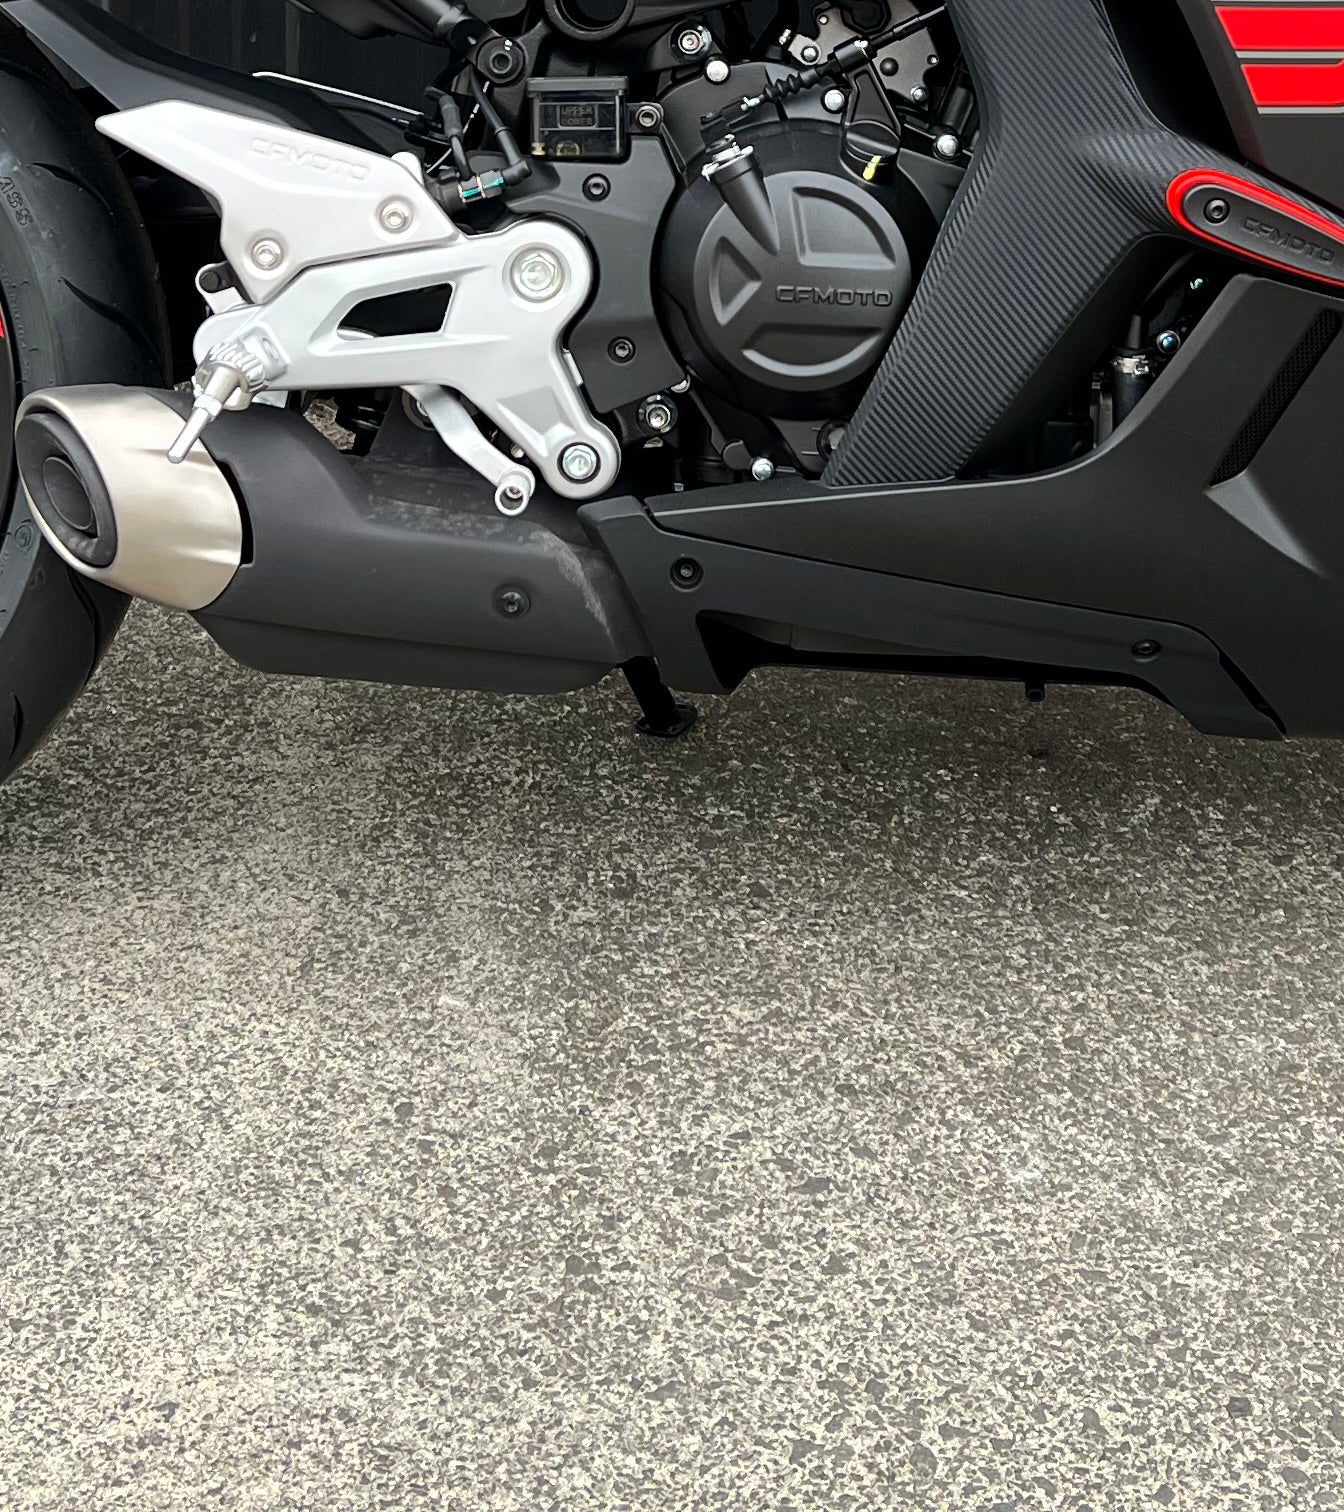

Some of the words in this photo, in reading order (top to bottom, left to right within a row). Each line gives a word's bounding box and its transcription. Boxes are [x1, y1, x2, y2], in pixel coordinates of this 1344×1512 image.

[560, 105, 593, 115] UPPER
[249, 137, 371, 180] CFMOTO
[1241, 216, 1335, 264] CFMOTO
[774, 284, 893, 308] CFMOTO
